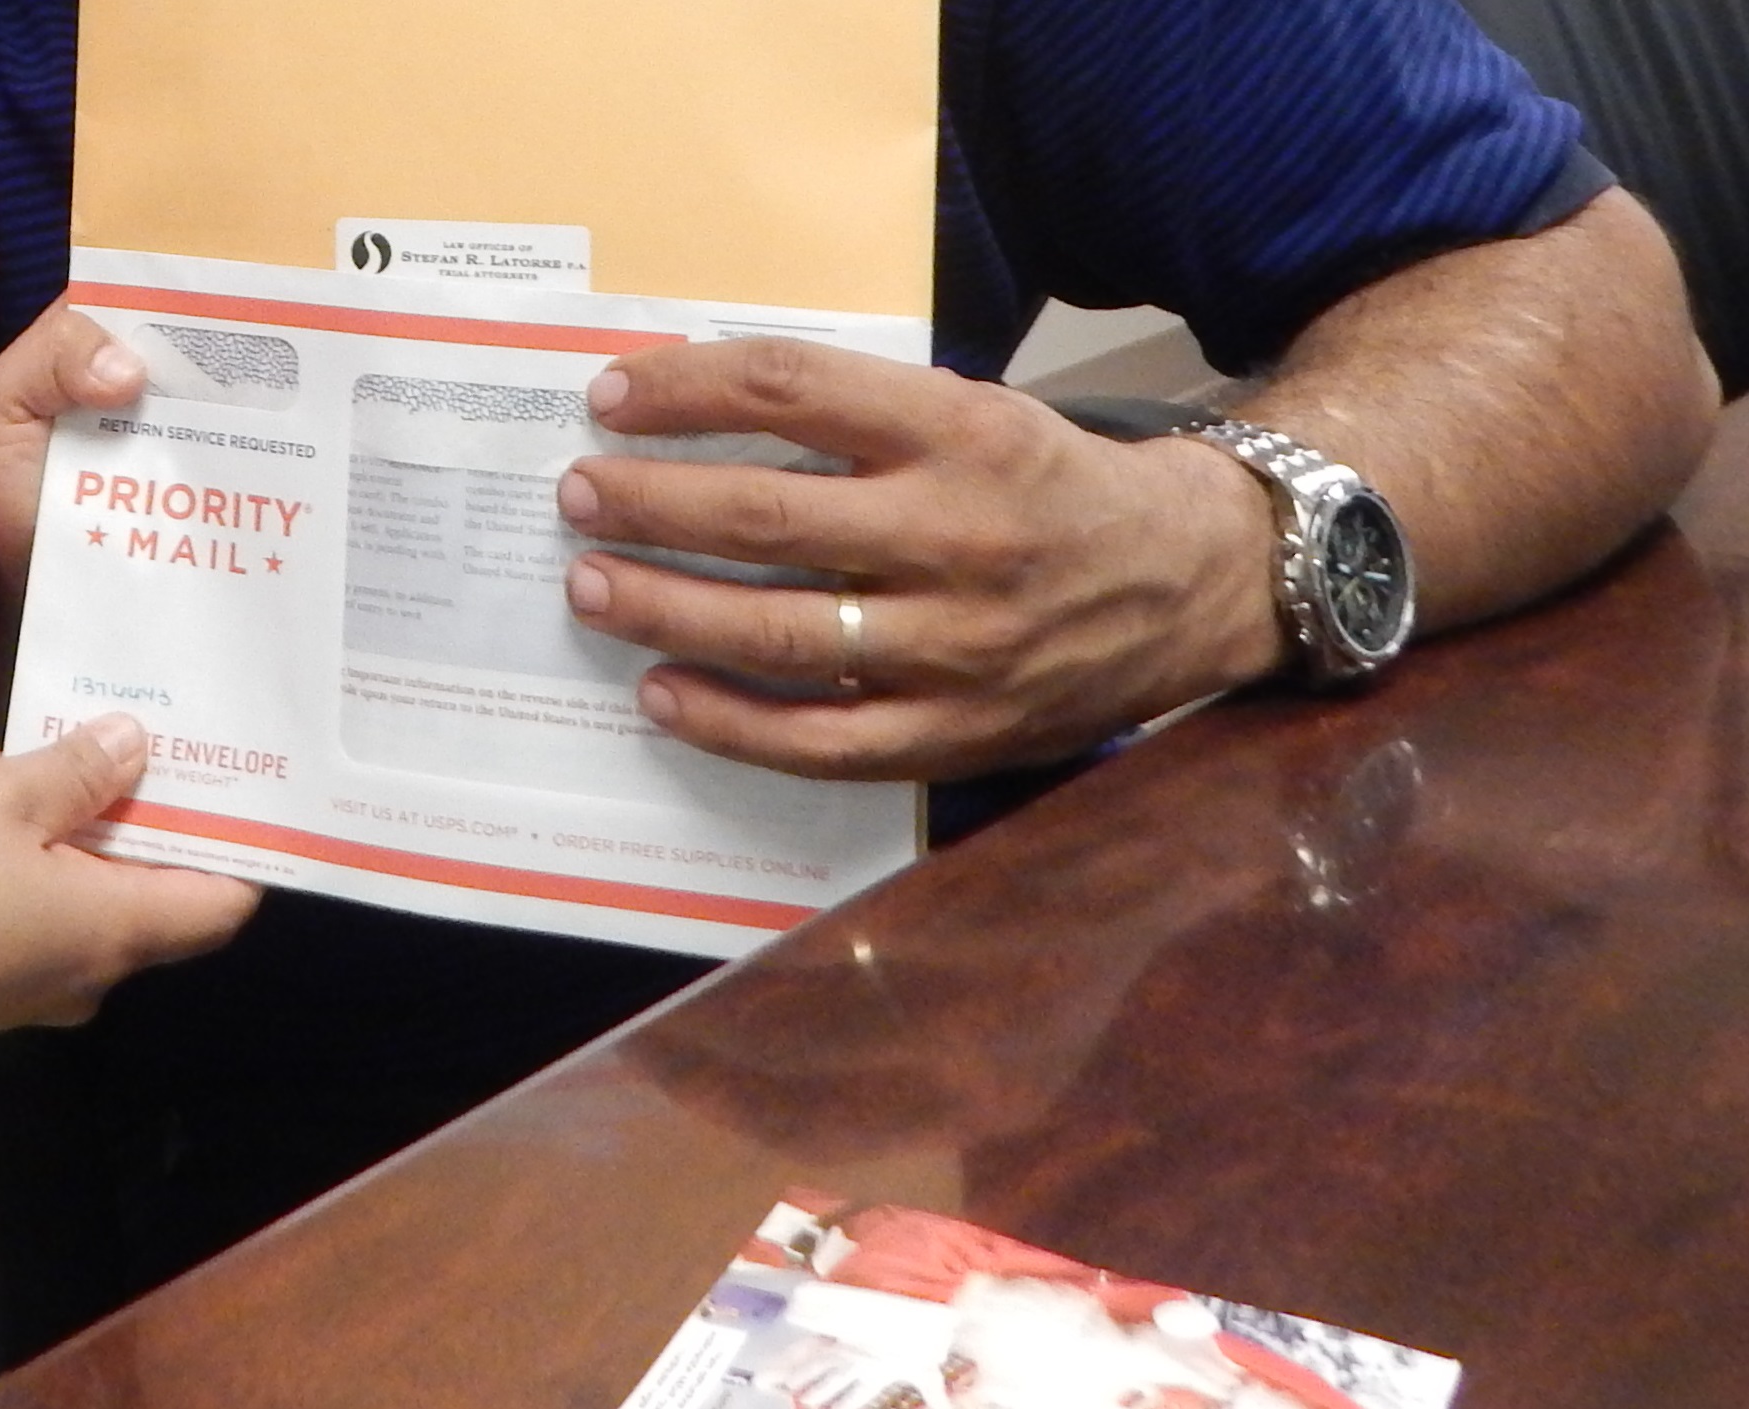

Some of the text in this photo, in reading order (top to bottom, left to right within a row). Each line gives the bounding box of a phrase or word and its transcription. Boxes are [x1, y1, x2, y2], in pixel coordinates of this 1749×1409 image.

[401, 249, 459, 265] STEFAN
[465, 253, 484, 266] R.
[490, 254, 562, 269] LATORRE
[99, 416, 316, 459] RETURN SERVICE REQUESTED
[127, 526, 247, 575] MAIL
[171, 737, 289, 780] ENVELOPE
[330, 797, 367, 816] VISIT
[371, 804, 393, 821] US
[398, 810, 420, 826] AT
[552, 831, 614, 853] ORDER
[620, 840, 665, 860] FREE
[670, 847, 755, 872] SUPPLIES
[759, 857, 831, 882] ONLINE
